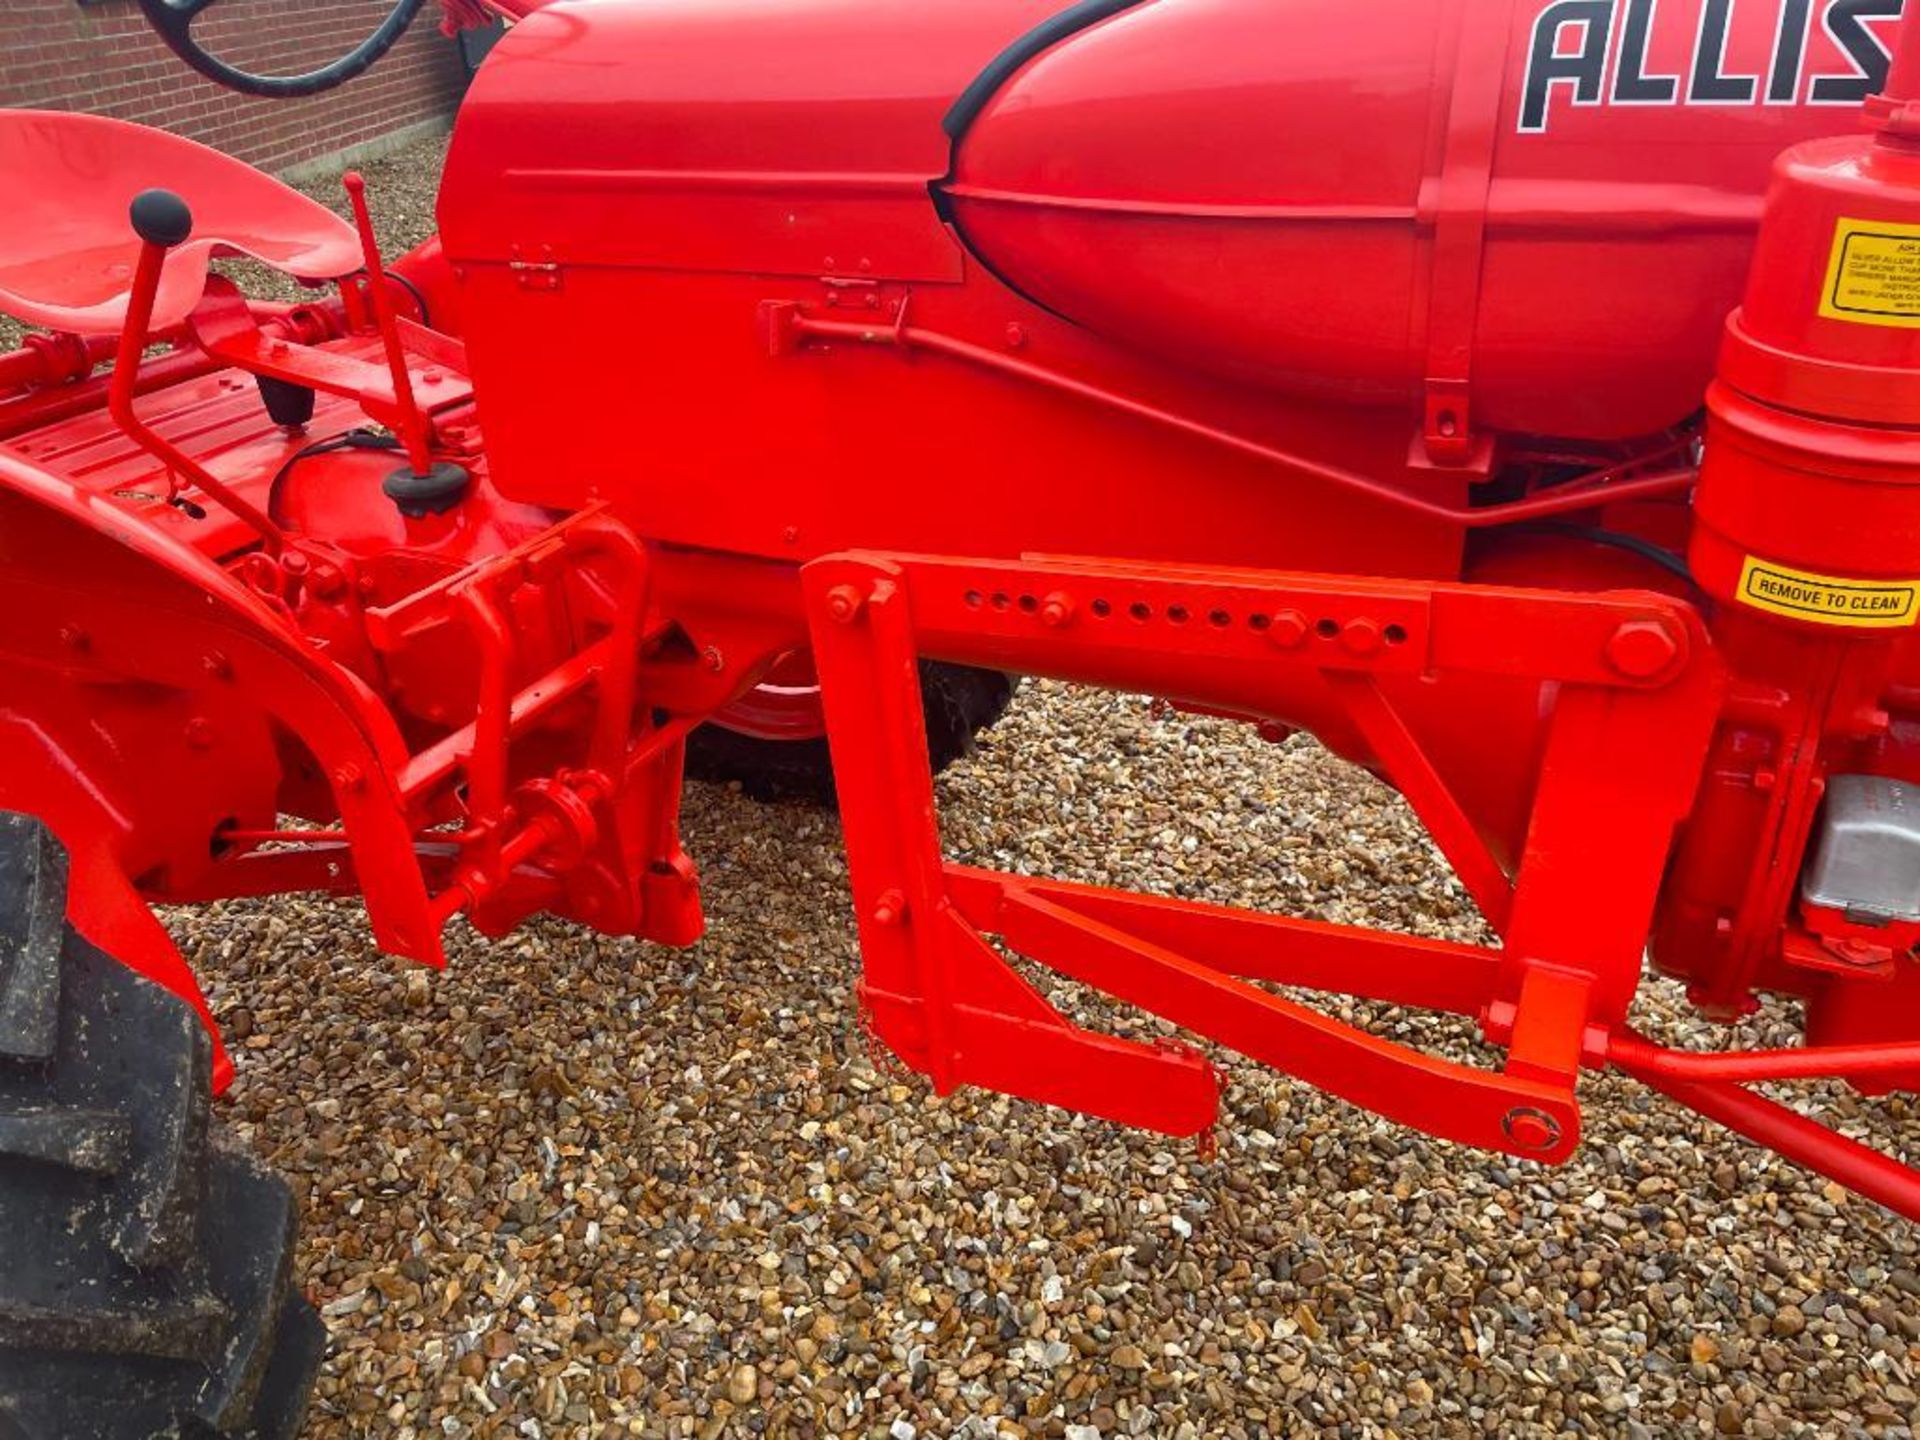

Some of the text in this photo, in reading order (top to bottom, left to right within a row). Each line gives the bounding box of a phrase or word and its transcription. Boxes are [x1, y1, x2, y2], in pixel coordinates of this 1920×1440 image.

[1517, 0, 1902, 133] ALLIS
[1759, 579, 1900, 609] REMOVE TO CLEAN
